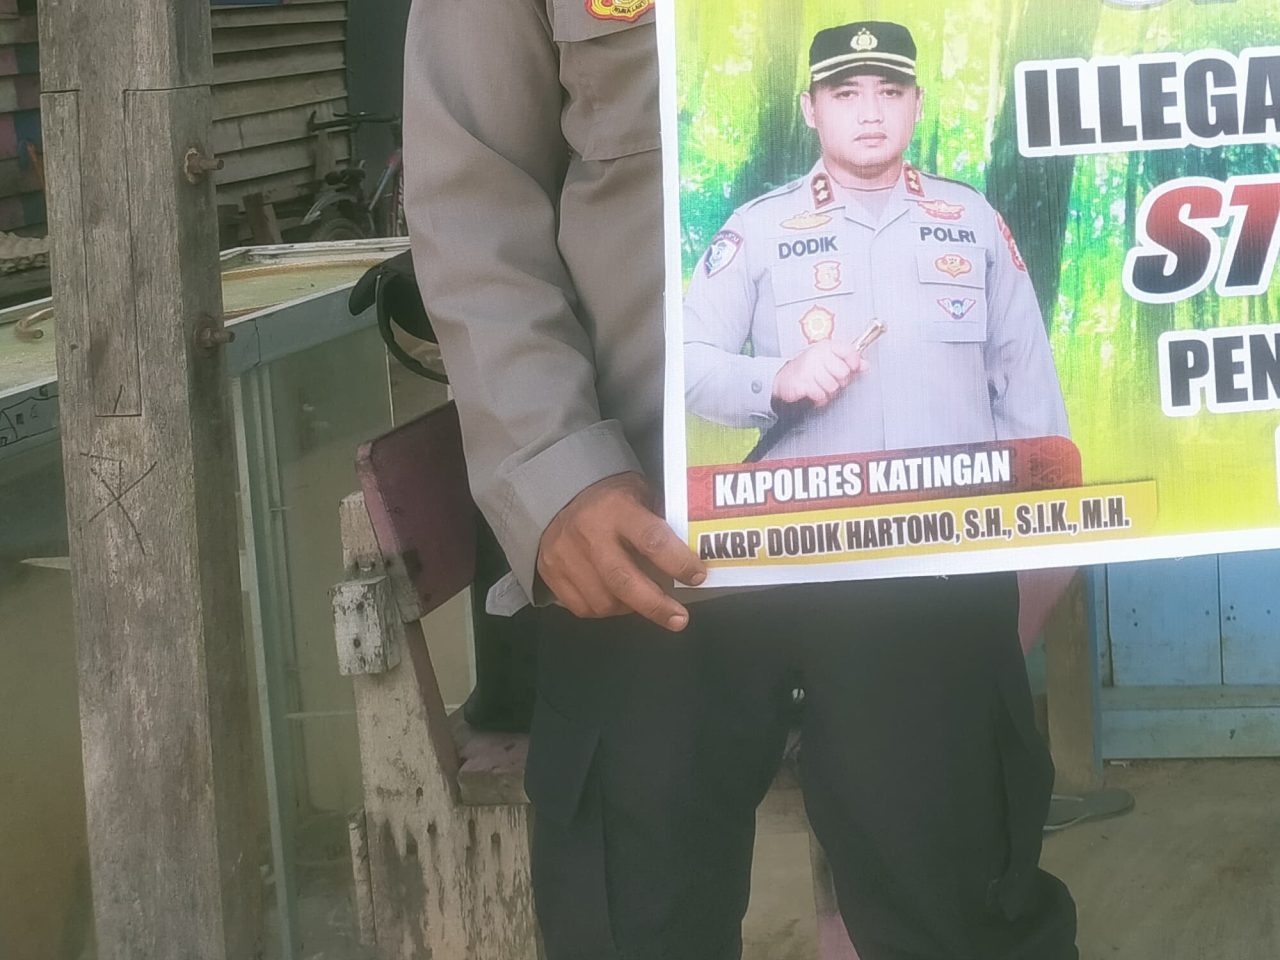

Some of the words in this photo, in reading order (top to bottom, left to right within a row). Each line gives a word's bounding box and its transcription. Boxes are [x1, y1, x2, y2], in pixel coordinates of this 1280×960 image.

[777, 235, 838, 260] DODIK
[919, 226, 977, 245] POLRI
[714, 459, 862, 507] KAPOLRES
[868, 449, 1011, 493] KATINGAN
[699, 531, 761, 561] AKBP
[767, 525, 841, 557] DODIK
[846, 514, 961, 551] HARTONO,
[965, 508, 1012, 539] S.H.,
[1016, 502, 1078, 535] S.I.K.,
[1082, 496, 1130, 530] M.H.
